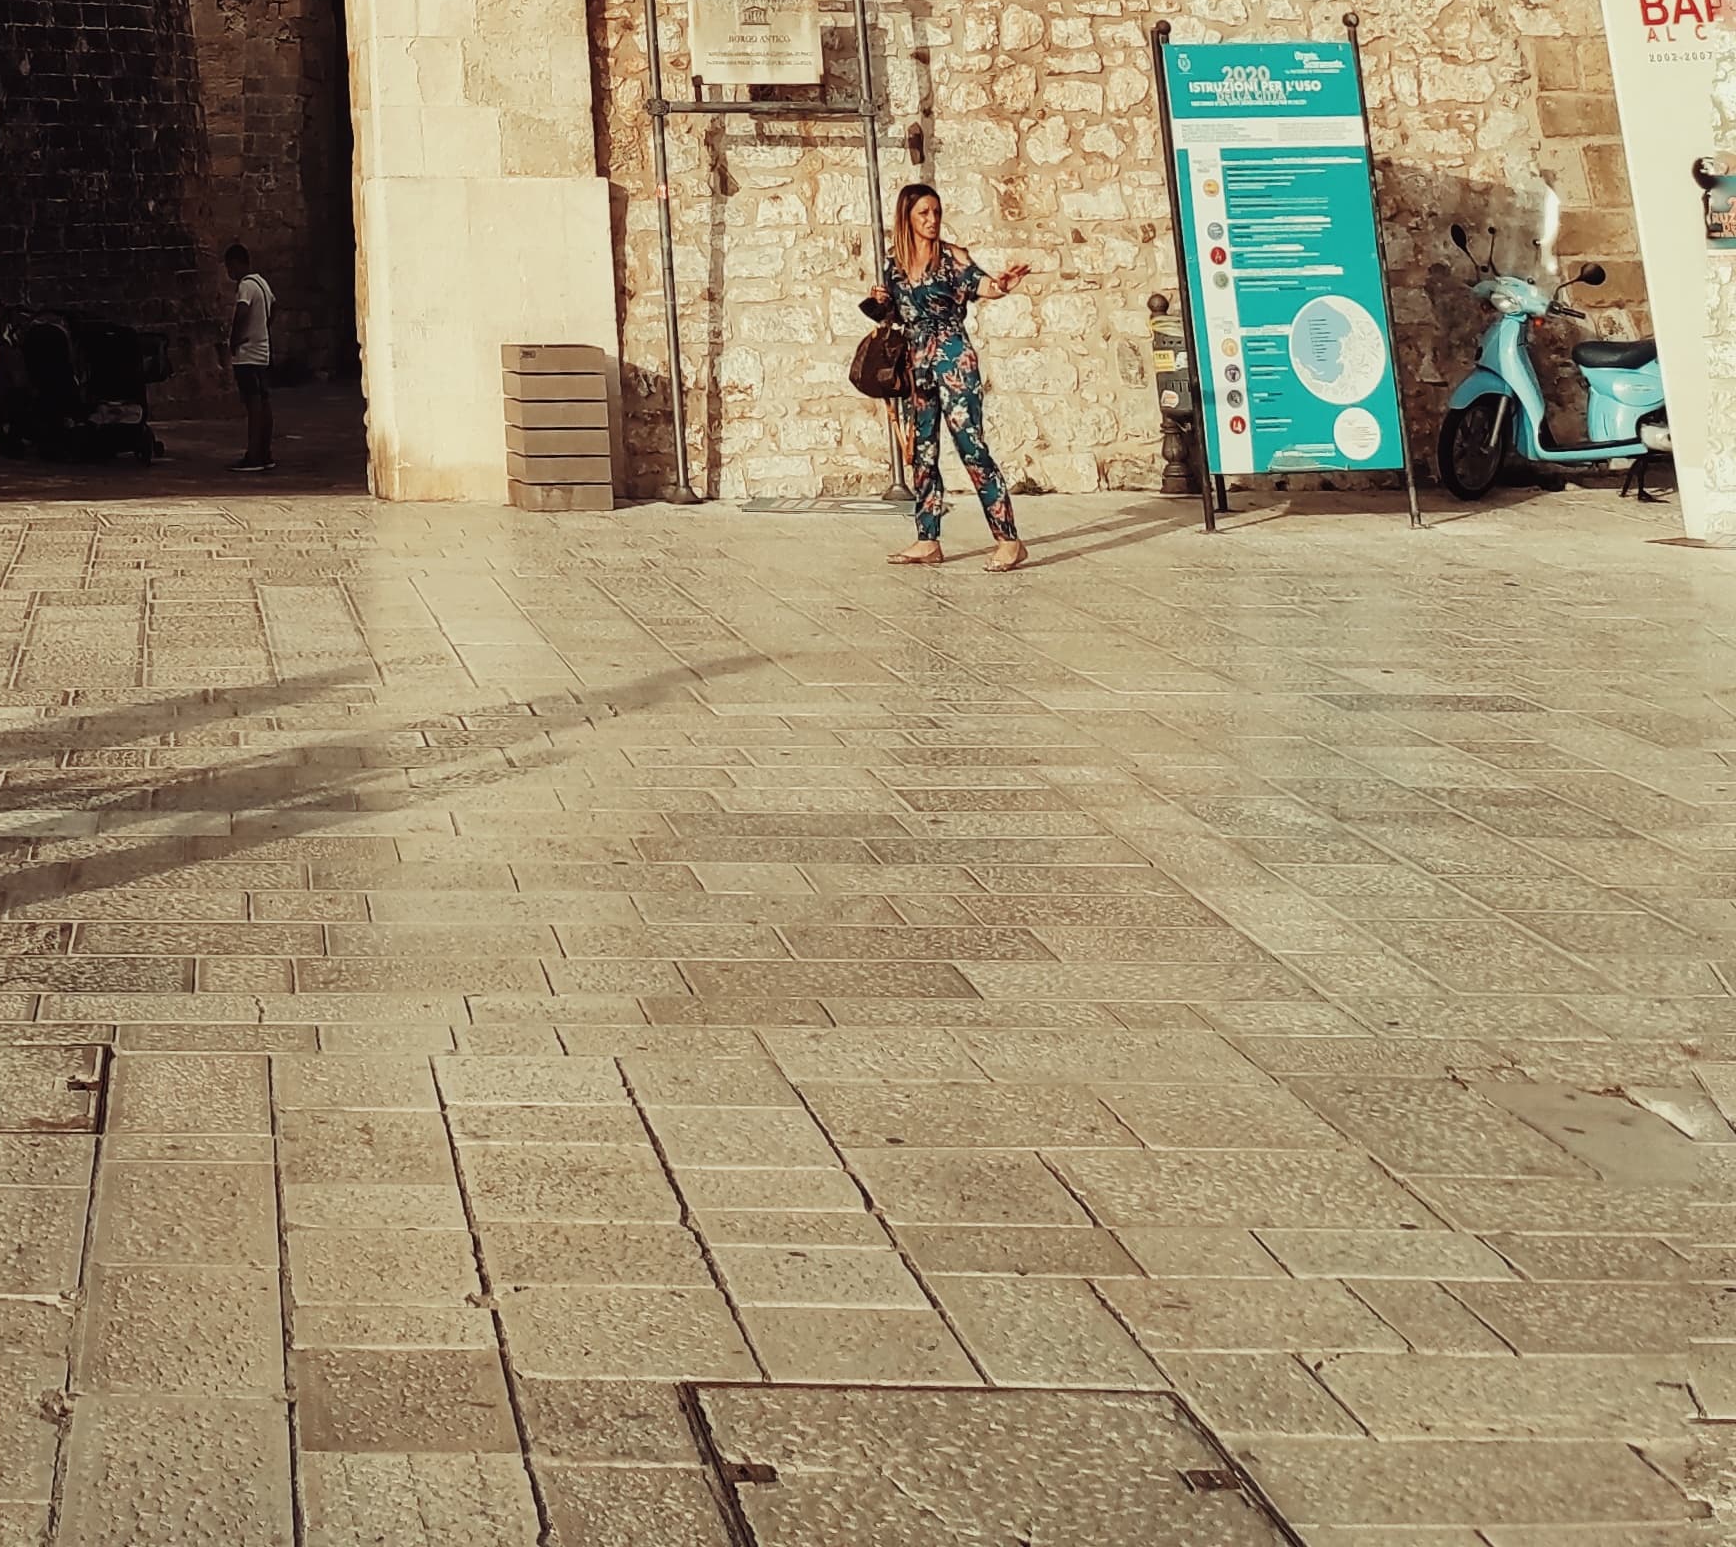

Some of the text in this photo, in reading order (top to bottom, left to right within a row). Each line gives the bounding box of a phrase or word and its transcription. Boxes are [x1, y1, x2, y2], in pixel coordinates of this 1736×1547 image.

[1647, 26, 1677, 43] AL
[1648, 51, 1713, 63] 2002-2007
[1221, 65, 1271, 83] 2020
[1189, 79, 1322, 93] ISTRUZIONI PER L'USO
